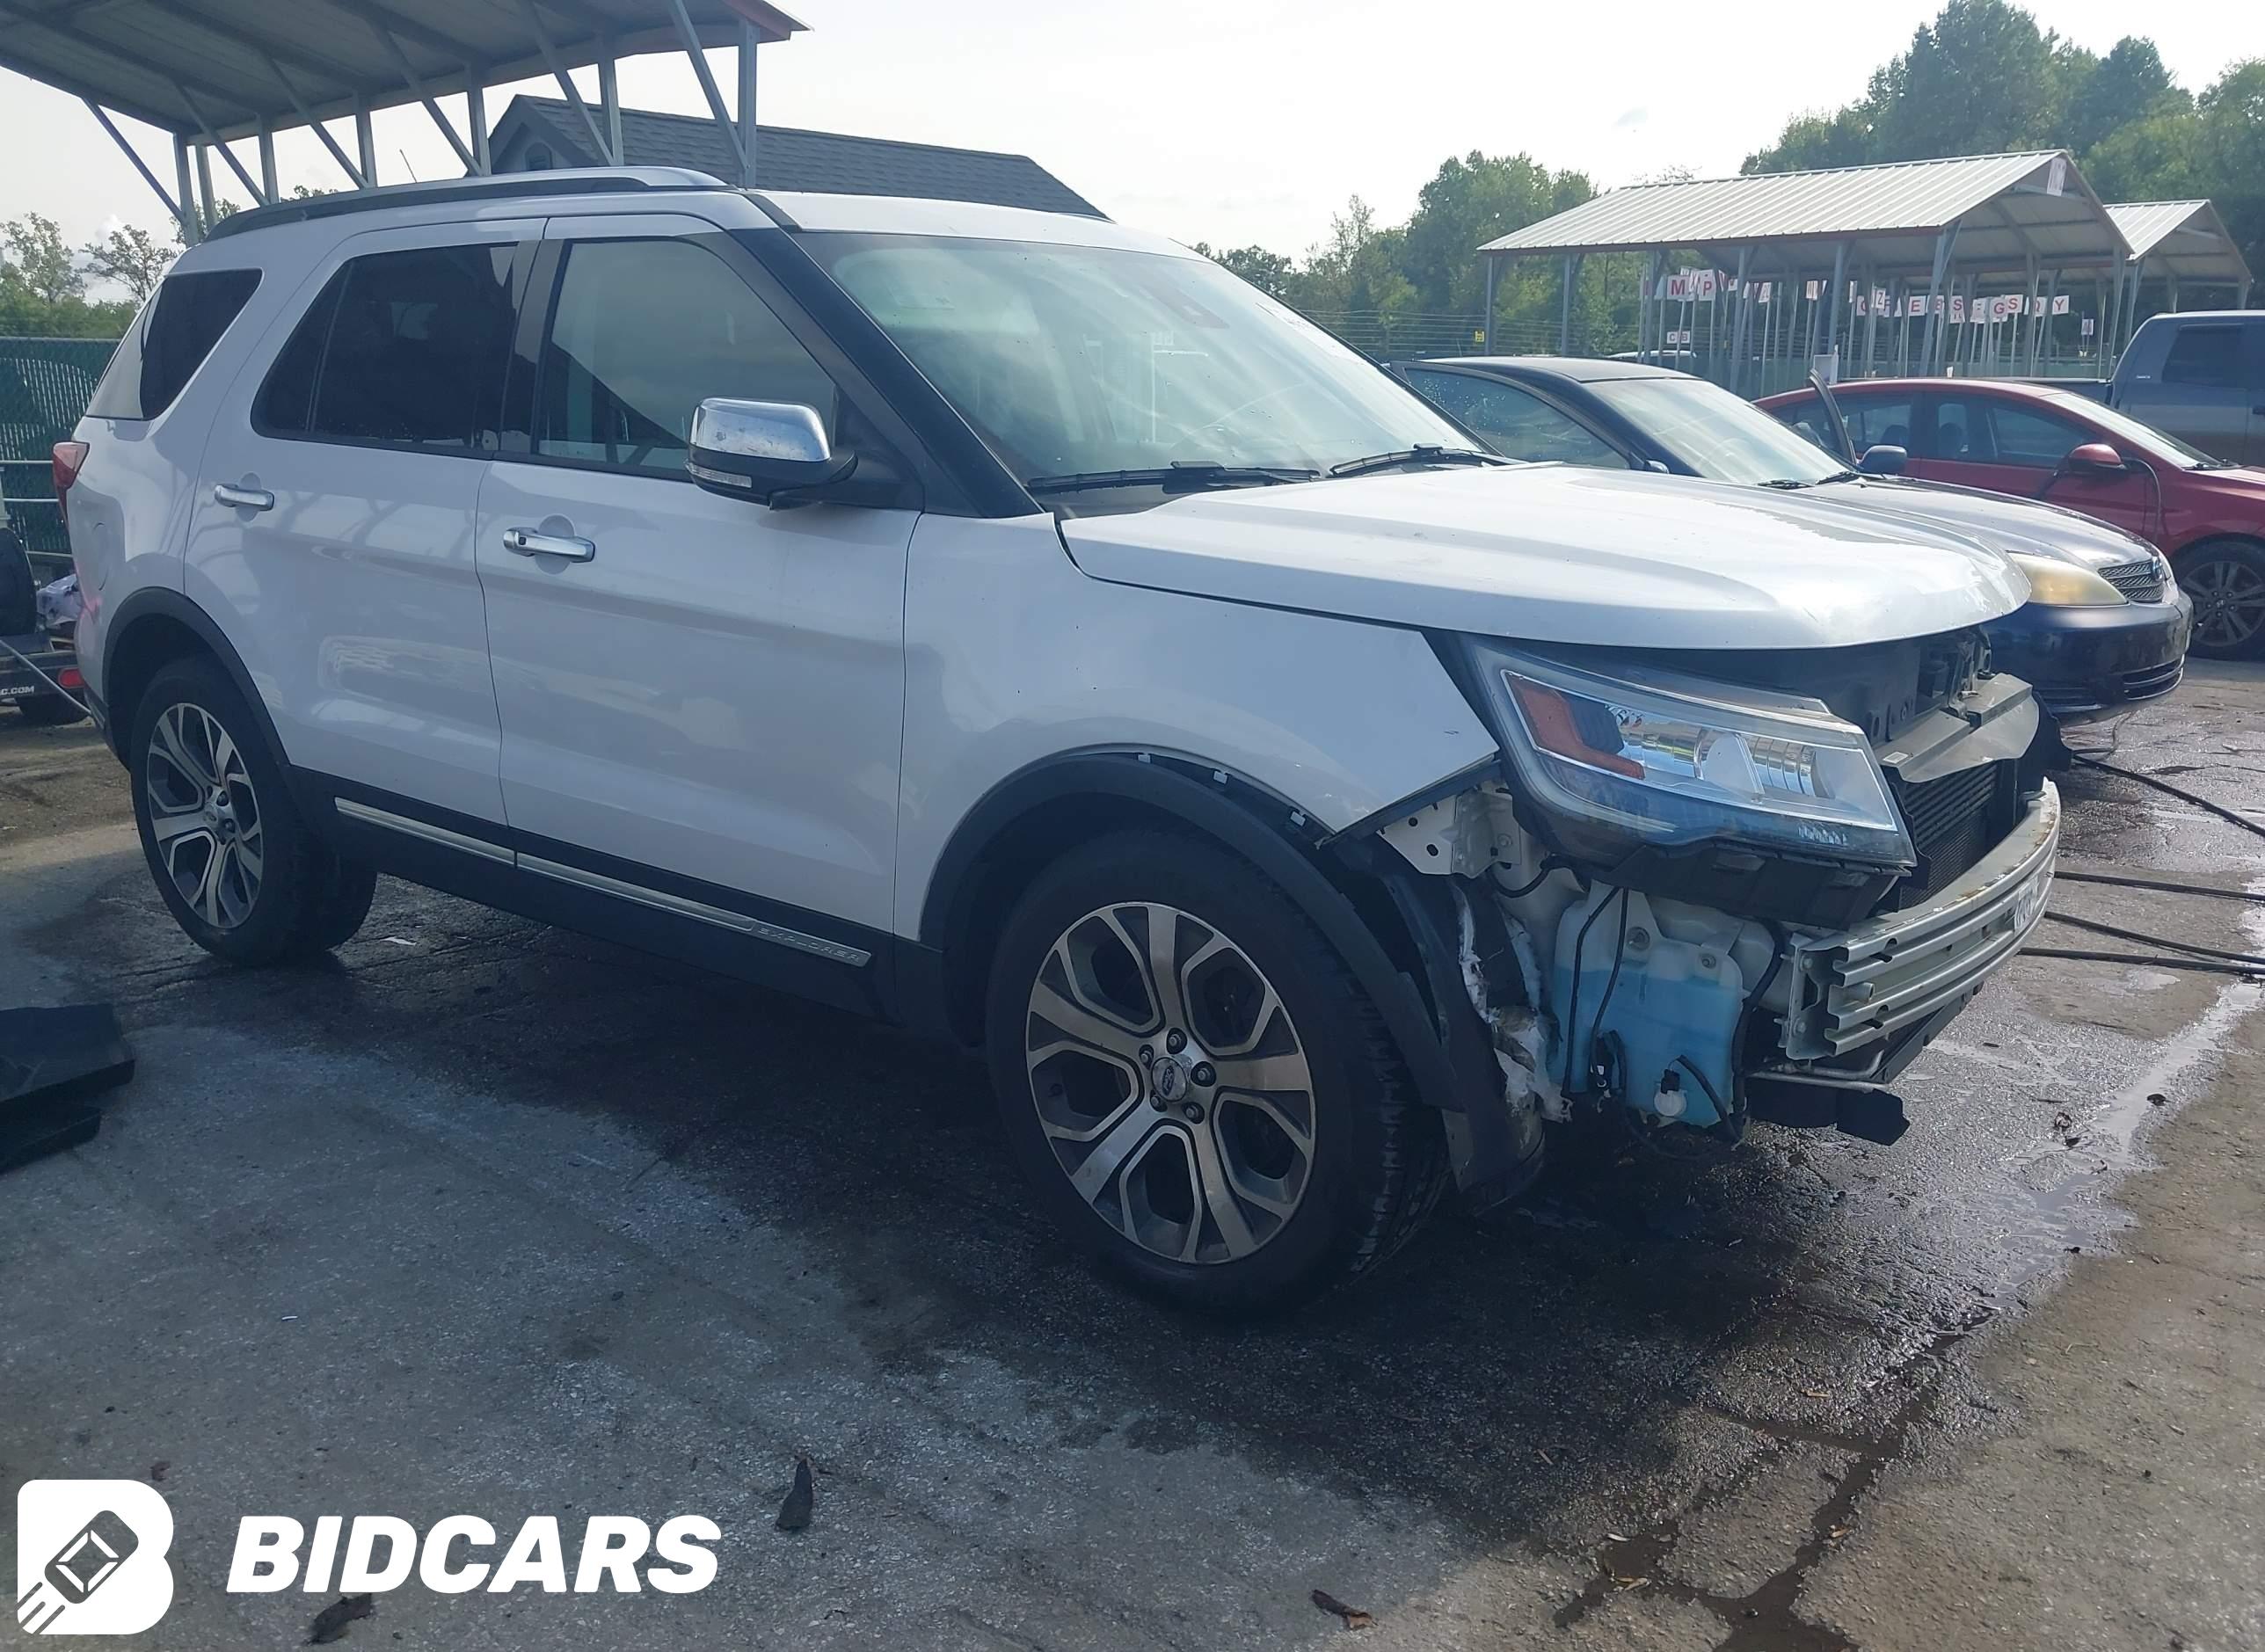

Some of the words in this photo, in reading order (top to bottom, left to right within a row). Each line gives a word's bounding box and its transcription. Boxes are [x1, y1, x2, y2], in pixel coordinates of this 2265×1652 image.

[1671, 280, 1686, 295] M
[1702, 280, 1712, 295] P
[1911, 300, 1920, 312] E
[1954, 299, 1963, 311] S
[1993, 302, 2005, 314] G
[2007, 298, 2018, 309] S
[2054, 299, 2065, 311] Y
